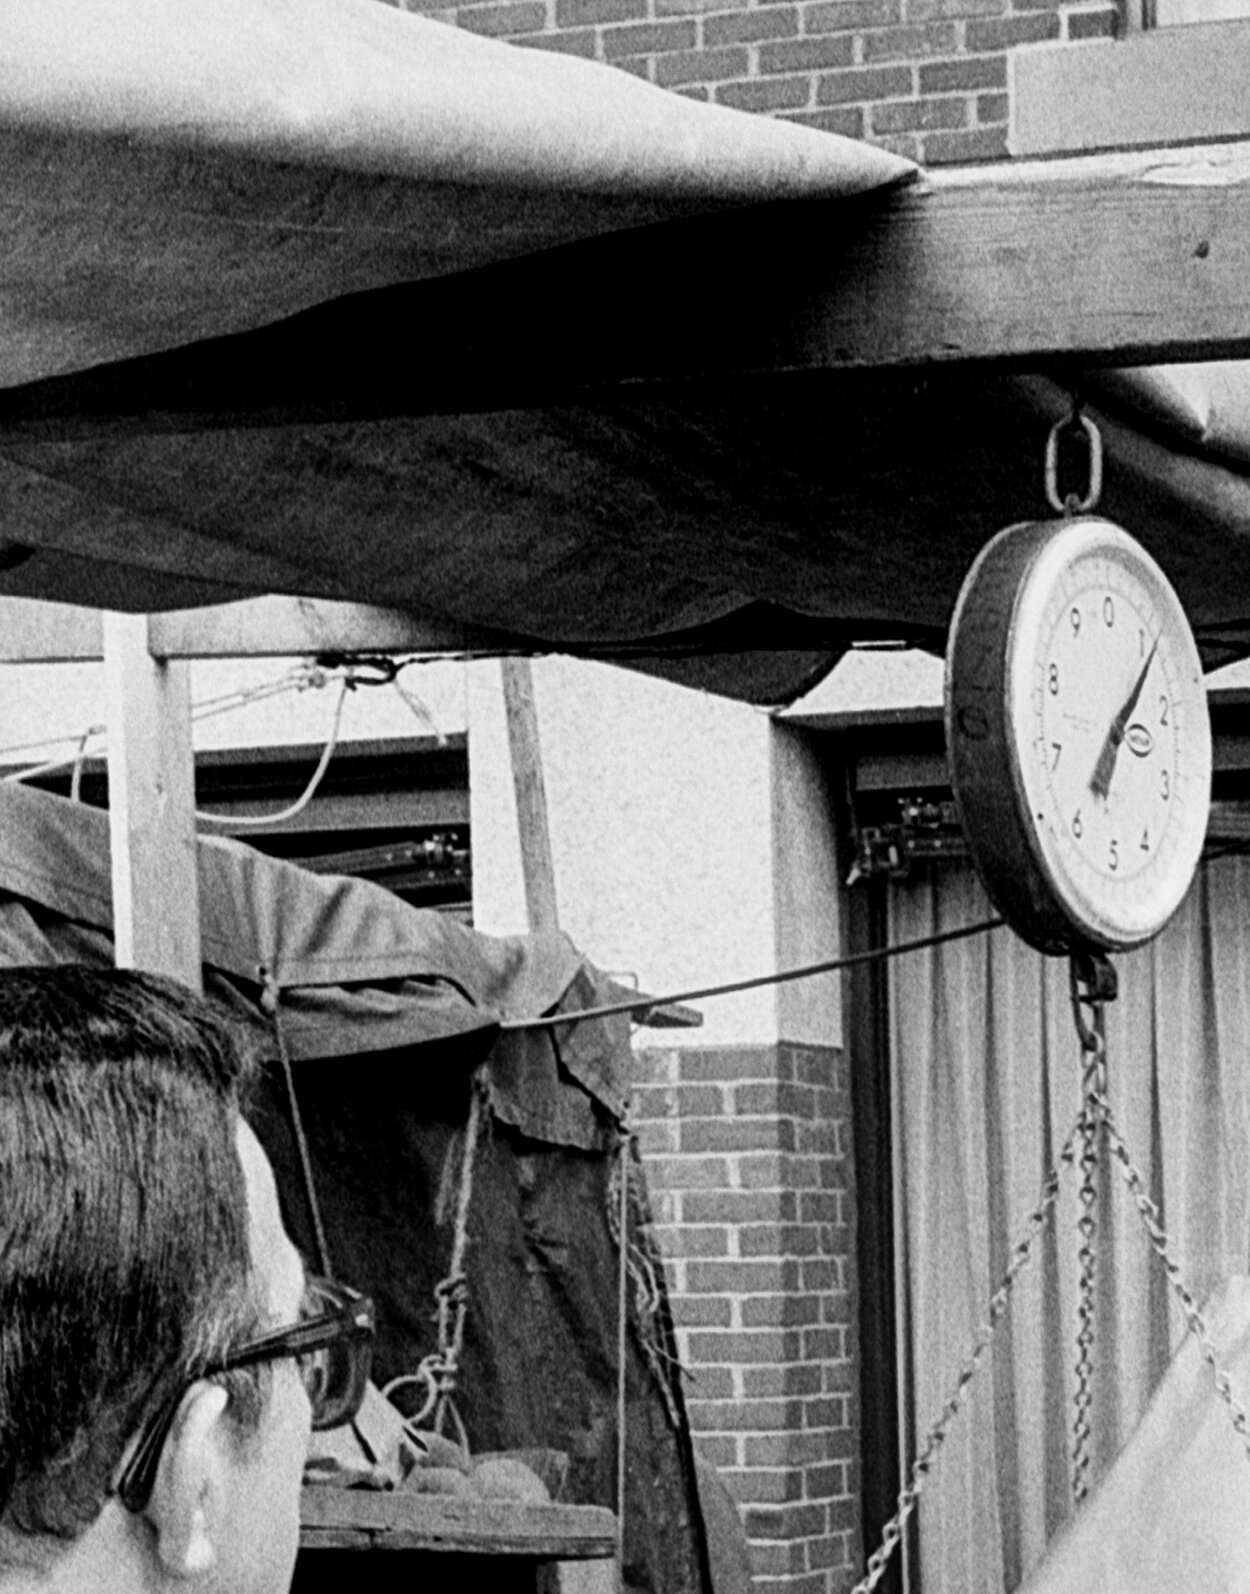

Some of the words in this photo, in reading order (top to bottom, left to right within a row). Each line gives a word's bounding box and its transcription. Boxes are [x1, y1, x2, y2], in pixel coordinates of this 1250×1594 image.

[1069, 607, 1081, 638] 9
[1102, 596, 1115, 628] 0
[1138, 628, 1146, 658] 1
[1048, 662, 1060, 696] 8
[1159, 694, 1169, 727] 2
[1051, 742, 1063, 772] 7
[1160, 768, 1170, 801] 3
[1072, 808, 1083, 839] 6
[1108, 839, 1119, 871] 5
